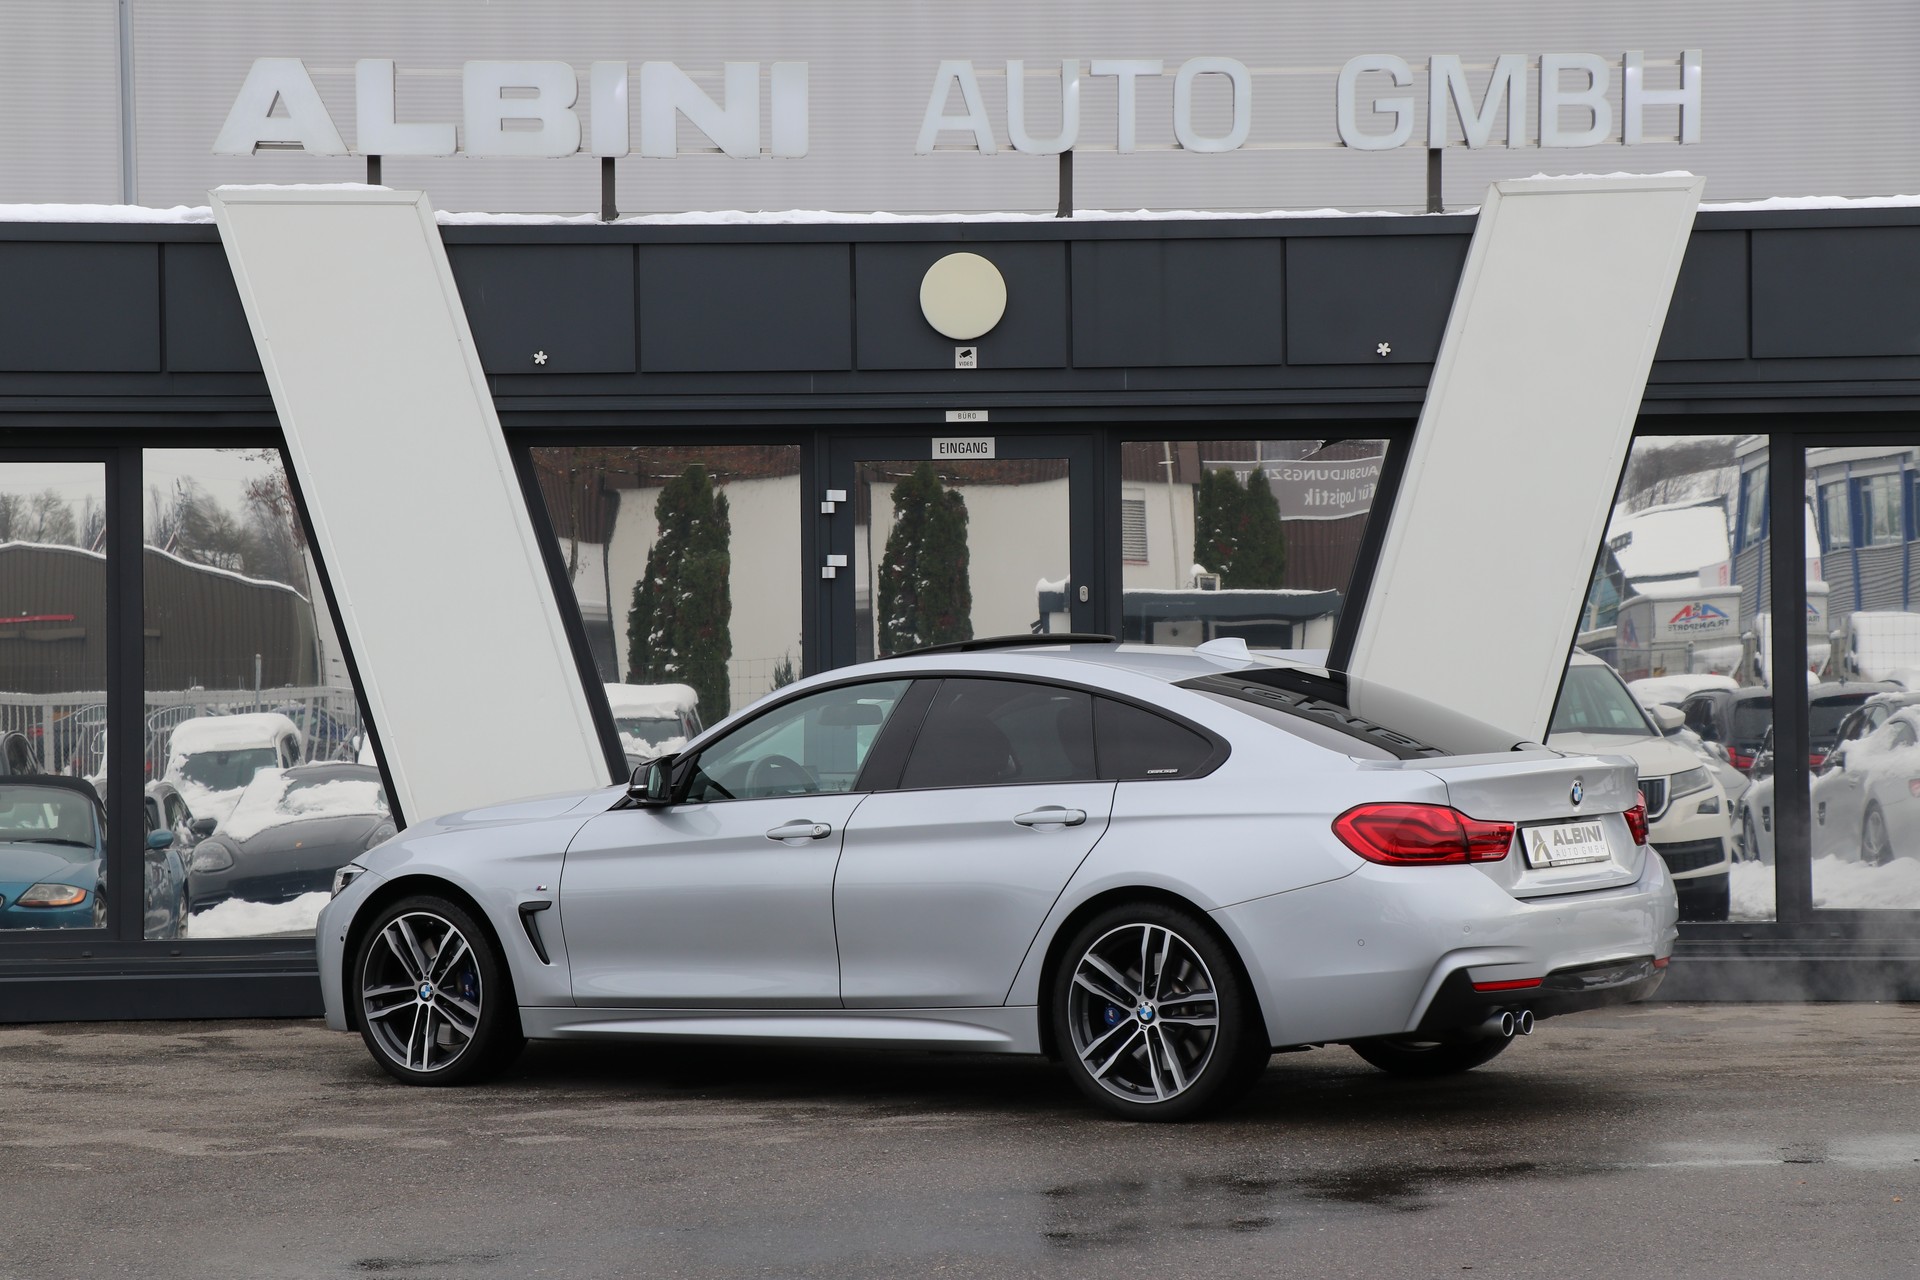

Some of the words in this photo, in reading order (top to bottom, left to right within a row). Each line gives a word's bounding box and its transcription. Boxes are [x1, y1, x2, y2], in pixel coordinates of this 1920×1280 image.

[212, 57, 809, 159] ALBINI
[915, 55, 1252, 156] AUTO
[1337, 49, 1703, 152] GMBH
[957, 411, 977, 420] BÜRO
[939, 441, 988, 454] EINGANG
[1554, 825, 1603, 846] ALBINI
[1556, 847, 1579, 857] AUTO
[1582, 844, 1606, 855] GMBH
